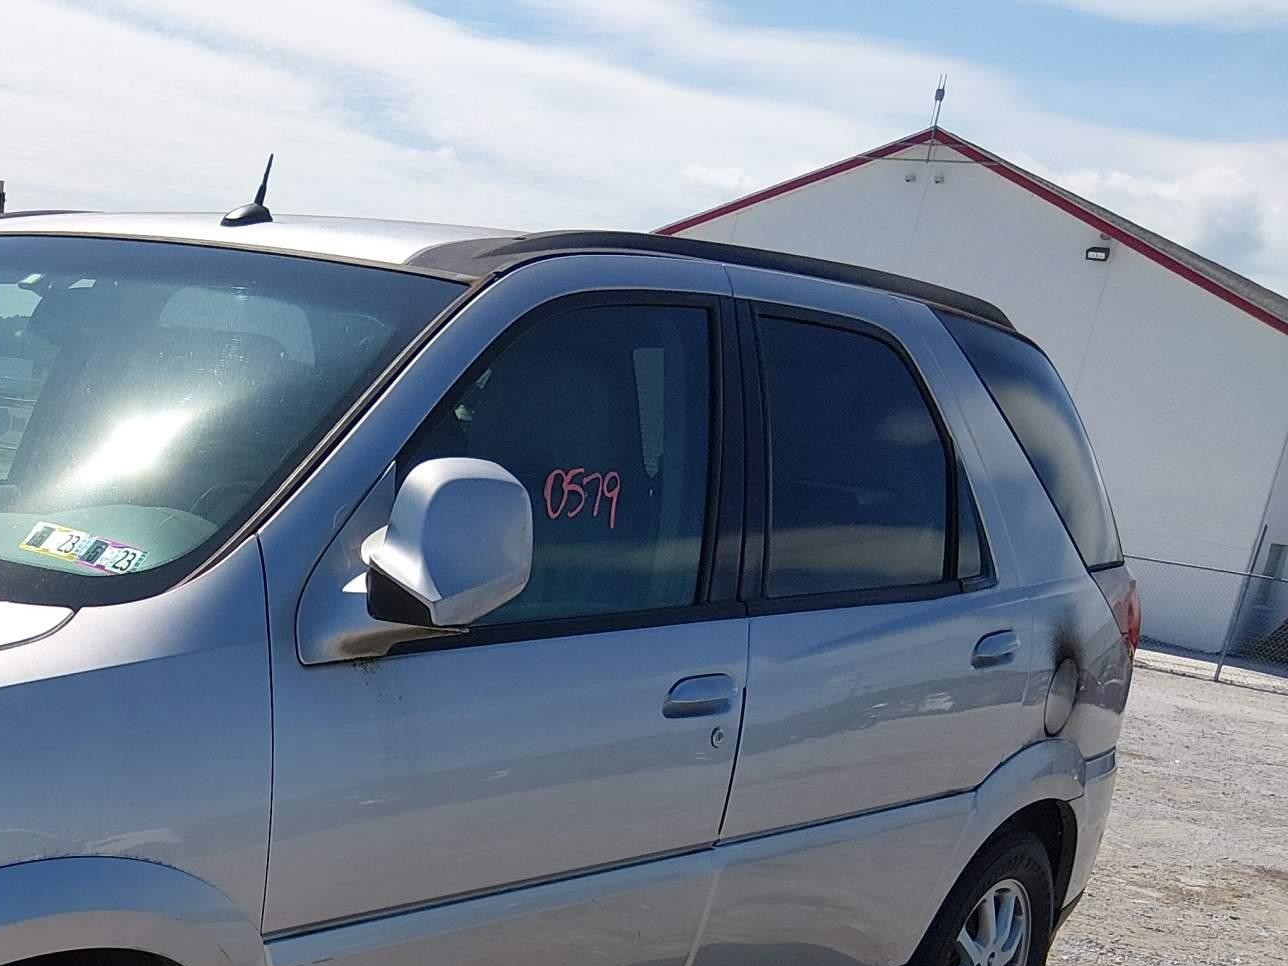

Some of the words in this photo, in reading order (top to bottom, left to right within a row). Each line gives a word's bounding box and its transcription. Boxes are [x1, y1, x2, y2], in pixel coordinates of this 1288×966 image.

[543, 467, 621, 529] 0579
[57, 534, 81, 553] 23
[112, 550, 137, 571] 23
